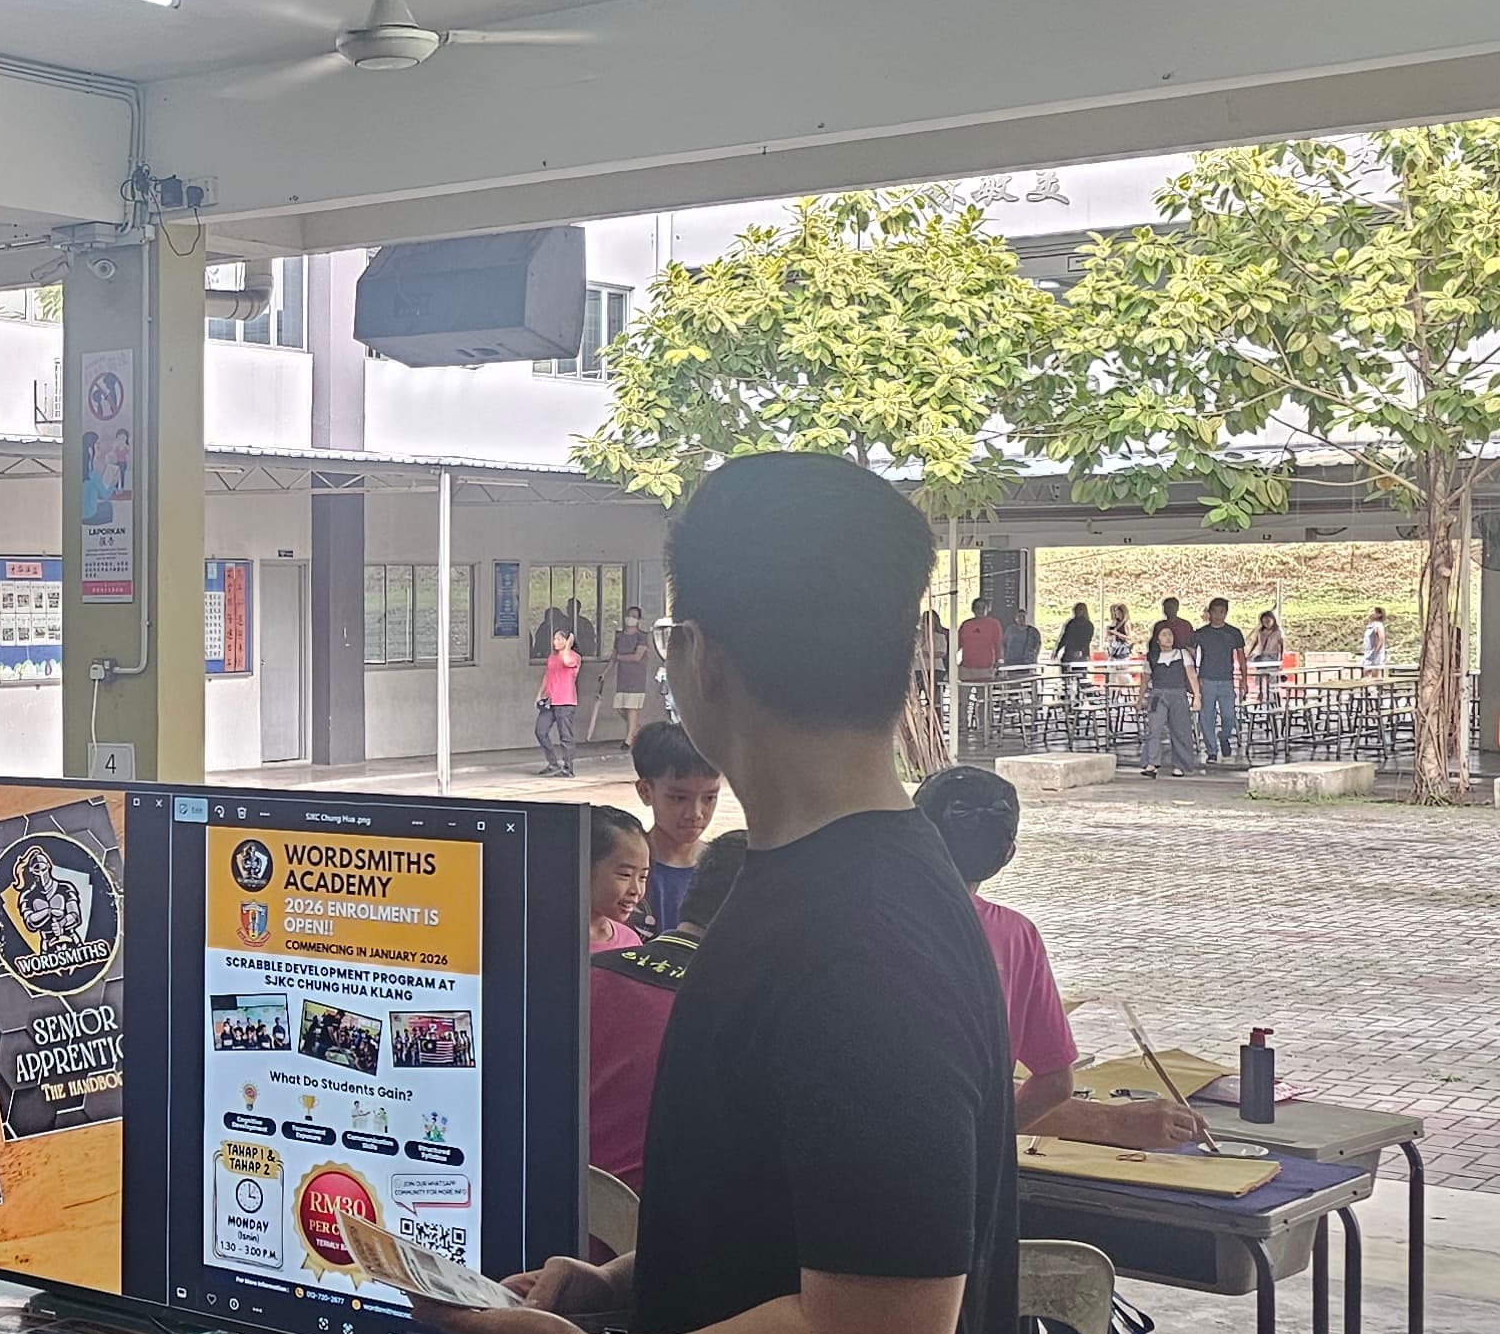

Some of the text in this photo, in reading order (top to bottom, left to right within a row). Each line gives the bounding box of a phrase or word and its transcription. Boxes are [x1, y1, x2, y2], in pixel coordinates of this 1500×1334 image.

[104, 753, 118, 775] 4
[284, 843, 437, 875] WORDSMITHS
[283, 870, 392, 898] ACADEMY
[284, 897, 440, 926] 2026 ENROLMENT IS
[283, 917, 334, 936] OPEN!!
[17, 942, 108, 974] WORDSMITHS
[285, 939, 448, 966] COMMENCING IN JANUARY 2026
[225, 956, 456, 991] SCRABBLE DEVELOPMENT PROGRAM AT
[264, 974, 413, 1002] SJKC CHUNG HUA KLANG
[32, 1005, 119, 1046] SENIOR
[270, 1070, 413, 1102] What Do Students Gain?
[227, 1143, 258, 1160] TAHAP
[266, 1149, 276, 1162] &
[229, 1157, 270, 1175] TAHAP 2
[227, 1215, 269, 1234] MONDAY
[309, 1218, 330, 1234] PER
